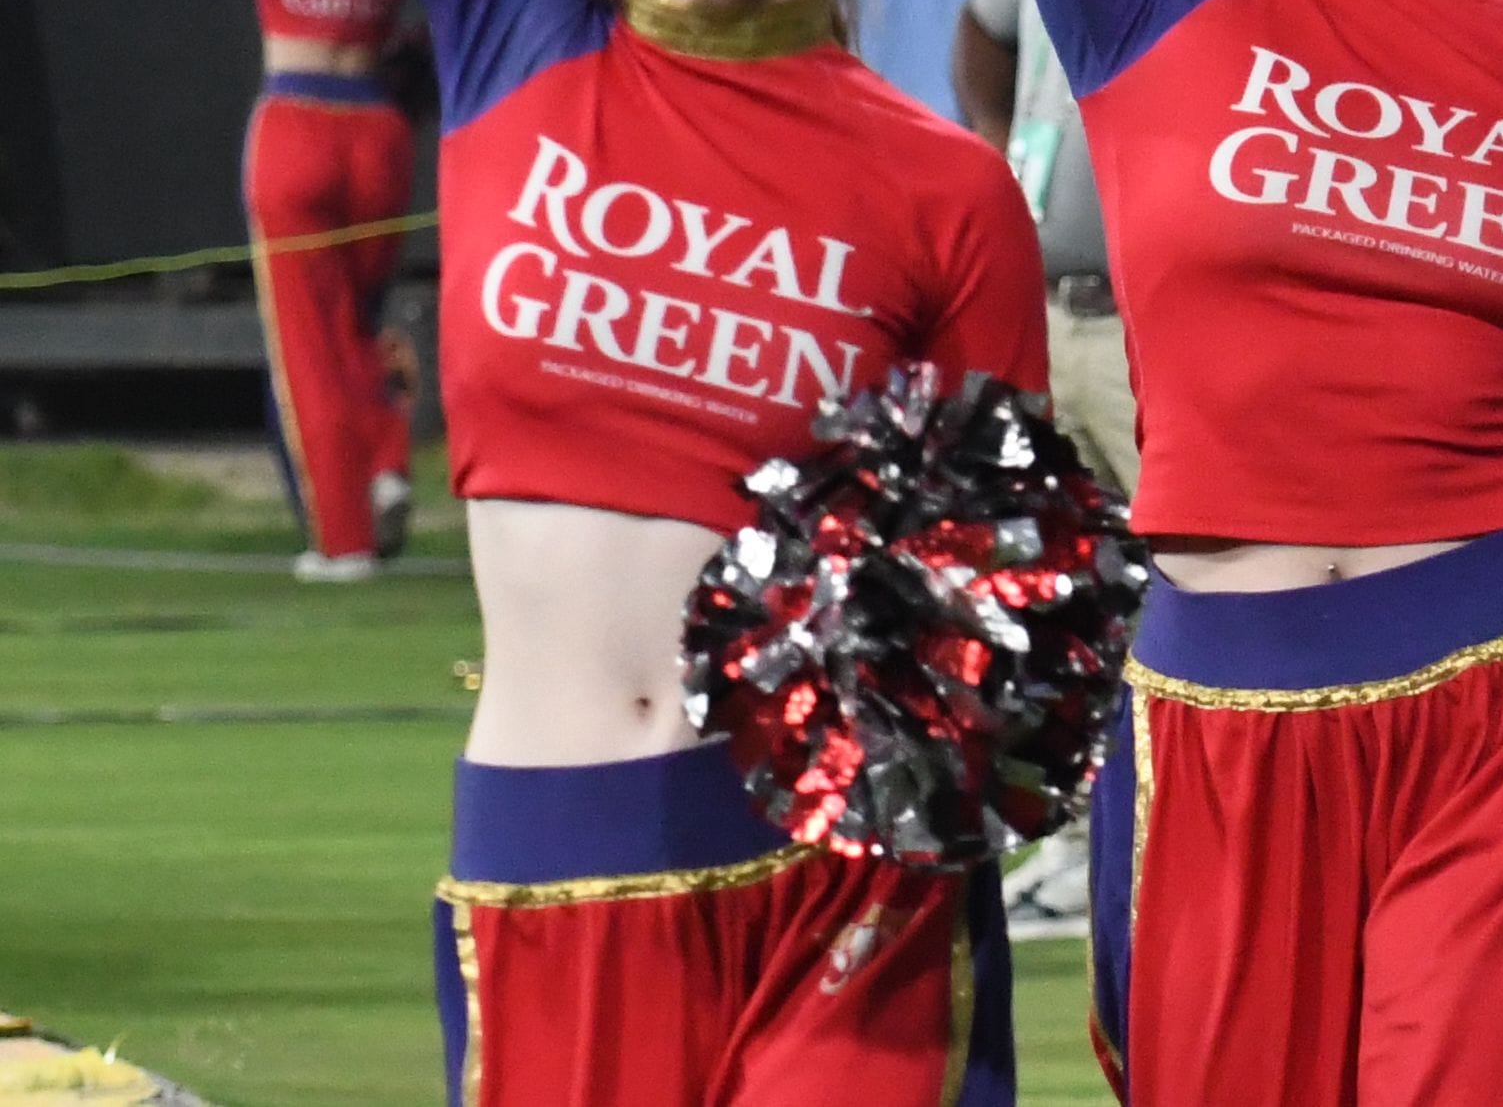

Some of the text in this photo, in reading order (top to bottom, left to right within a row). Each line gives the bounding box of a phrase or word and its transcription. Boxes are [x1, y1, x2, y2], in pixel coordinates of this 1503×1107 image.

[507, 134, 873, 317] ROYAL
[1291, 222, 1376, 249] PACKAGED
[1379, 239, 1454, 268] DRINKING
[481, 241, 864, 408] GREEN
